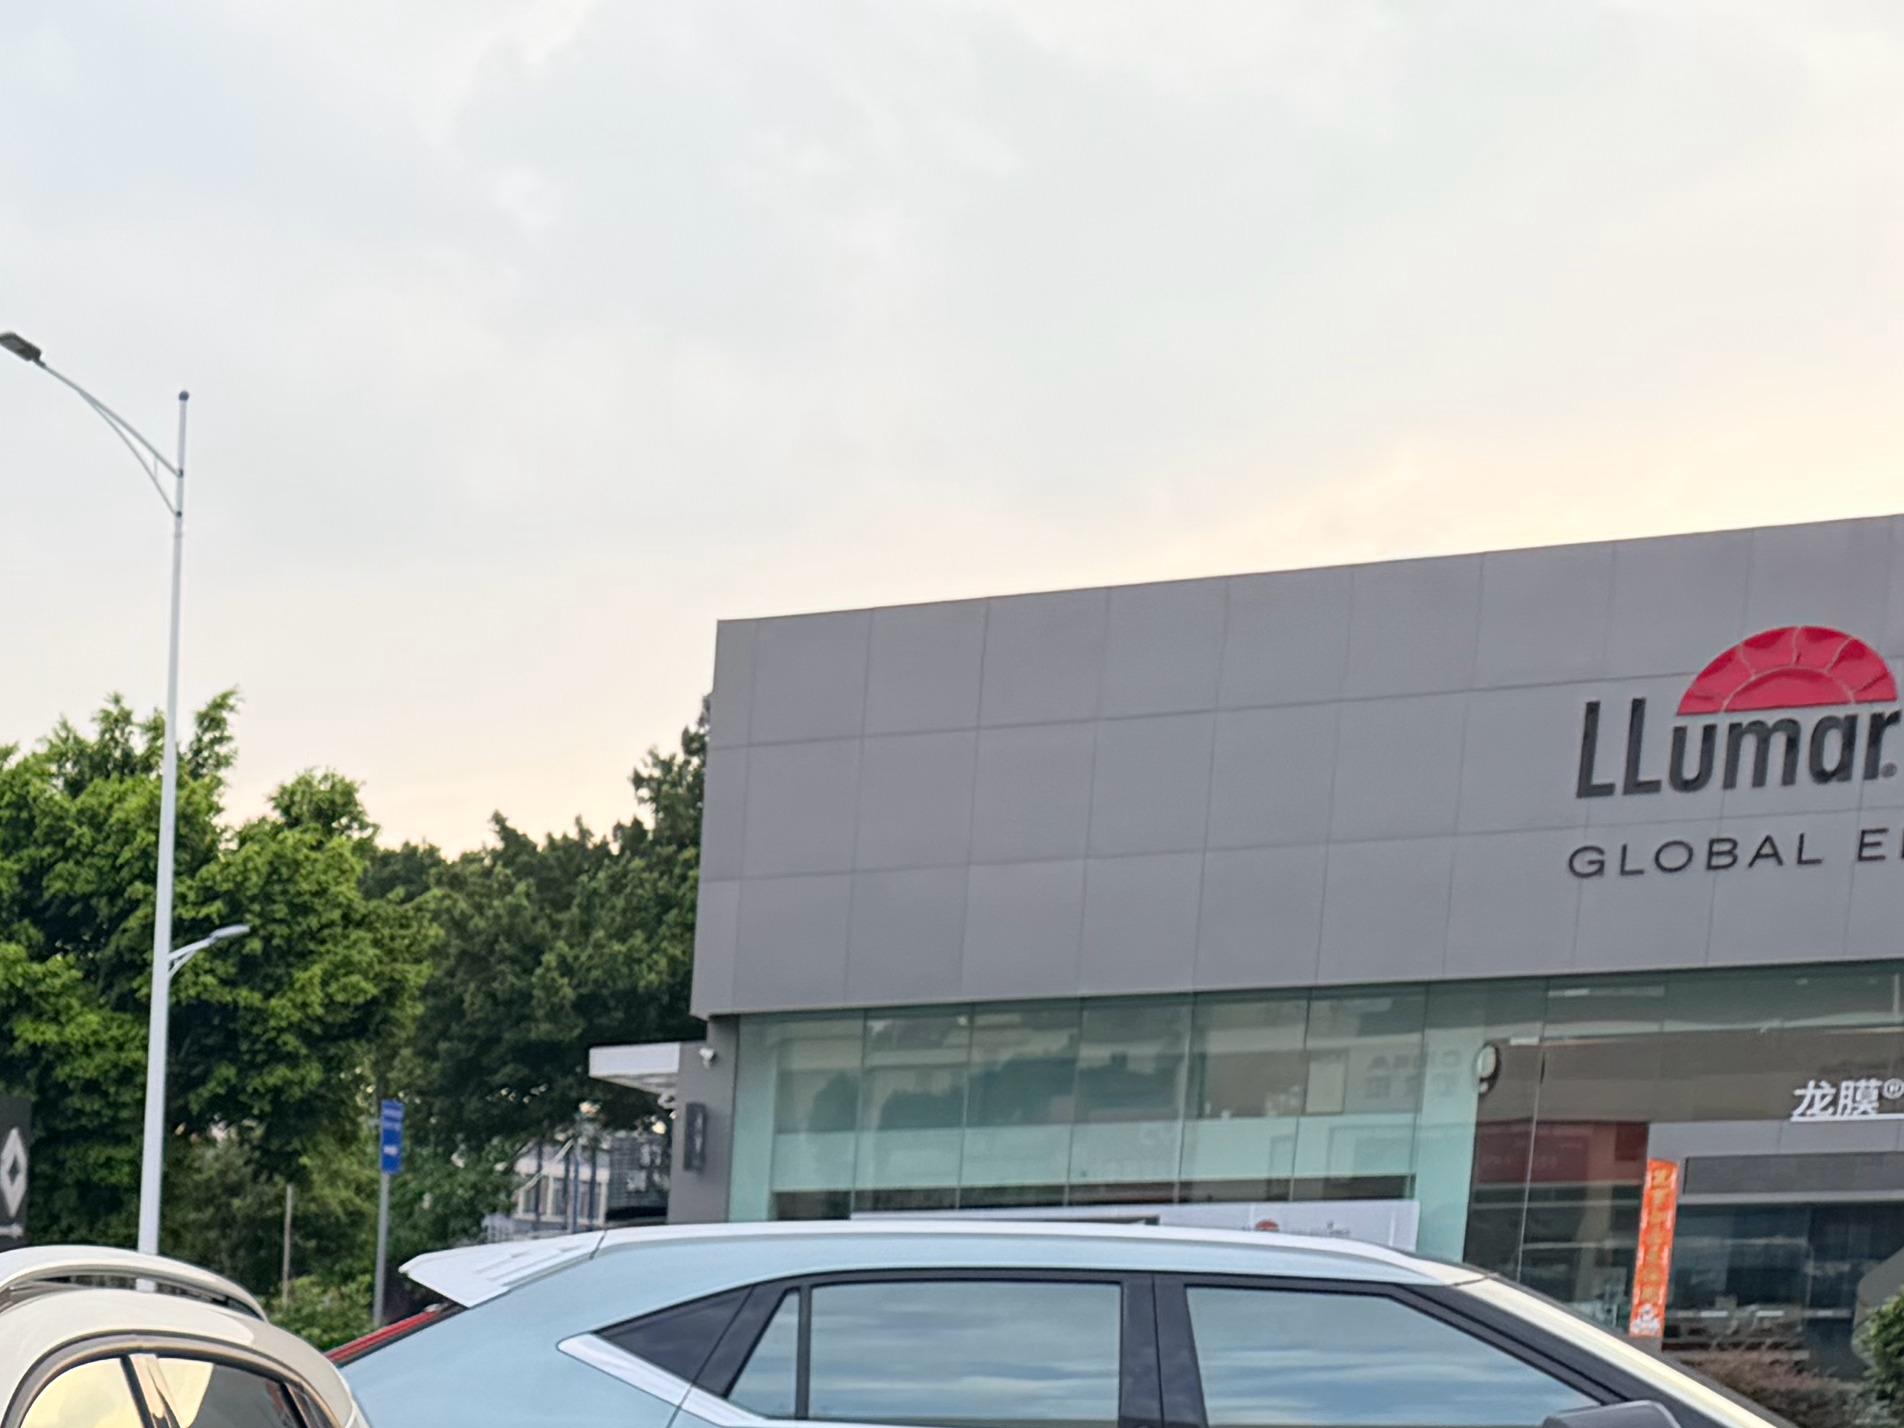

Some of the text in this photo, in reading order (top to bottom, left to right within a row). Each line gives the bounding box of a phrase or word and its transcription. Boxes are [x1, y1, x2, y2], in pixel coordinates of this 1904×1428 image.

[1576, 698, 1903, 798] LLumar
[1568, 828, 1904, 878] GLOBAL E
